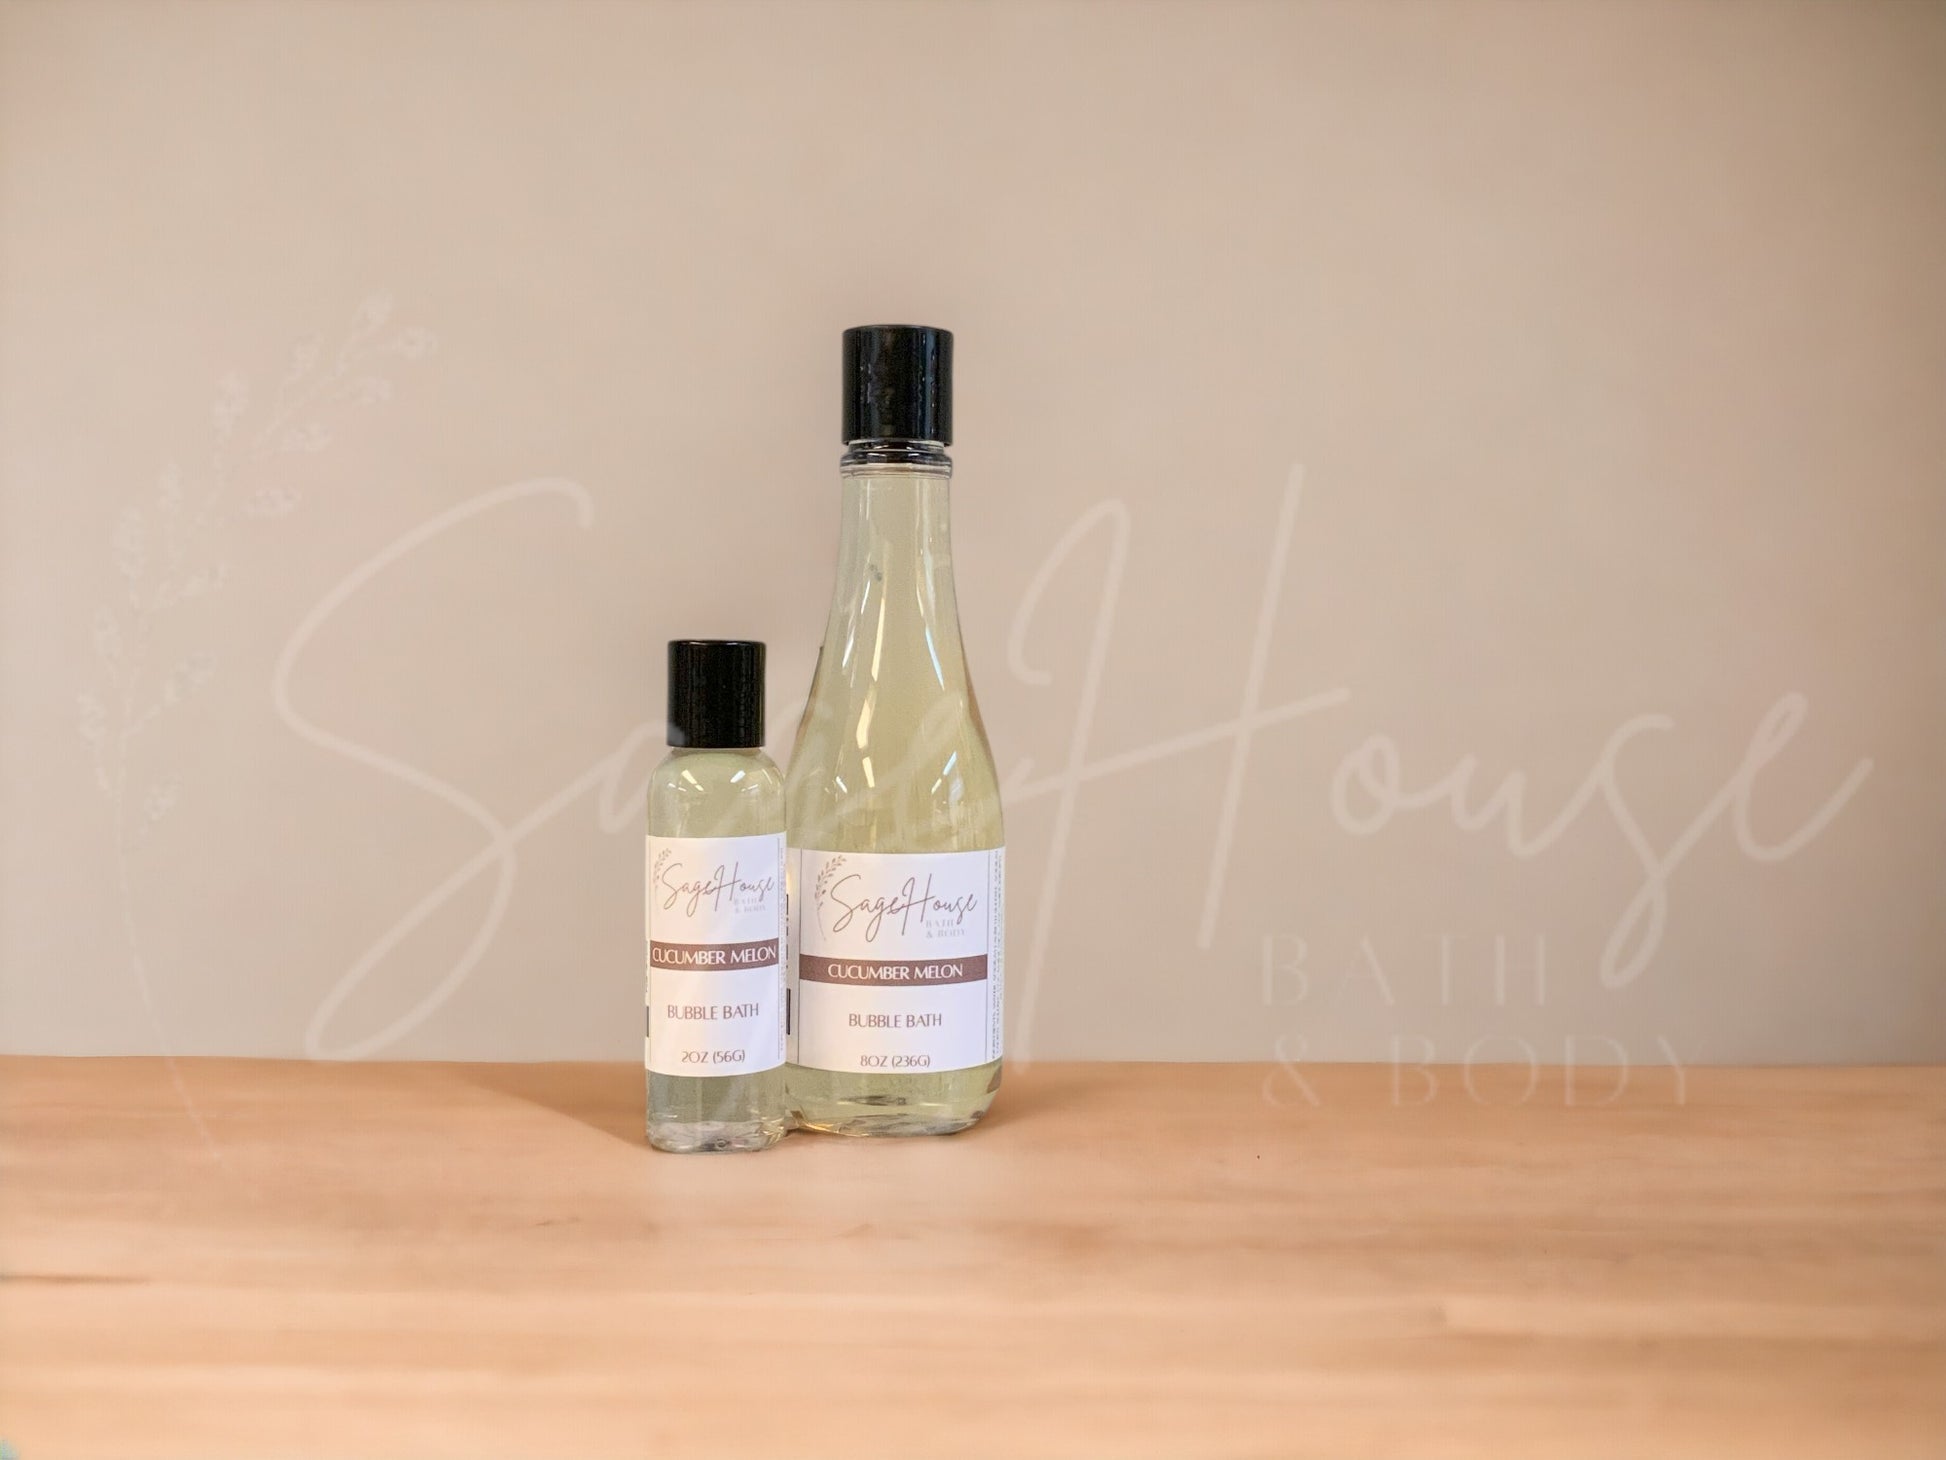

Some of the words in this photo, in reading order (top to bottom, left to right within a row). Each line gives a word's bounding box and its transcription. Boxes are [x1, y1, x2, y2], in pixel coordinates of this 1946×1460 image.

[652, 947, 726, 965] CUCUMBER
[731, 946, 776, 963] MELON
[828, 964, 910, 980] CUCUMBER
[914, 963, 963, 980] MELON
[667, 1005, 718, 1020] BUBBLE
[723, 1003, 759, 1019] BATH
[848, 1013, 901, 1029] BUBBLE
[905, 1013, 943, 1028] BATH
[712, 1049, 746, 1064] (56G)
[891, 1054, 931, 1068] (236G)
